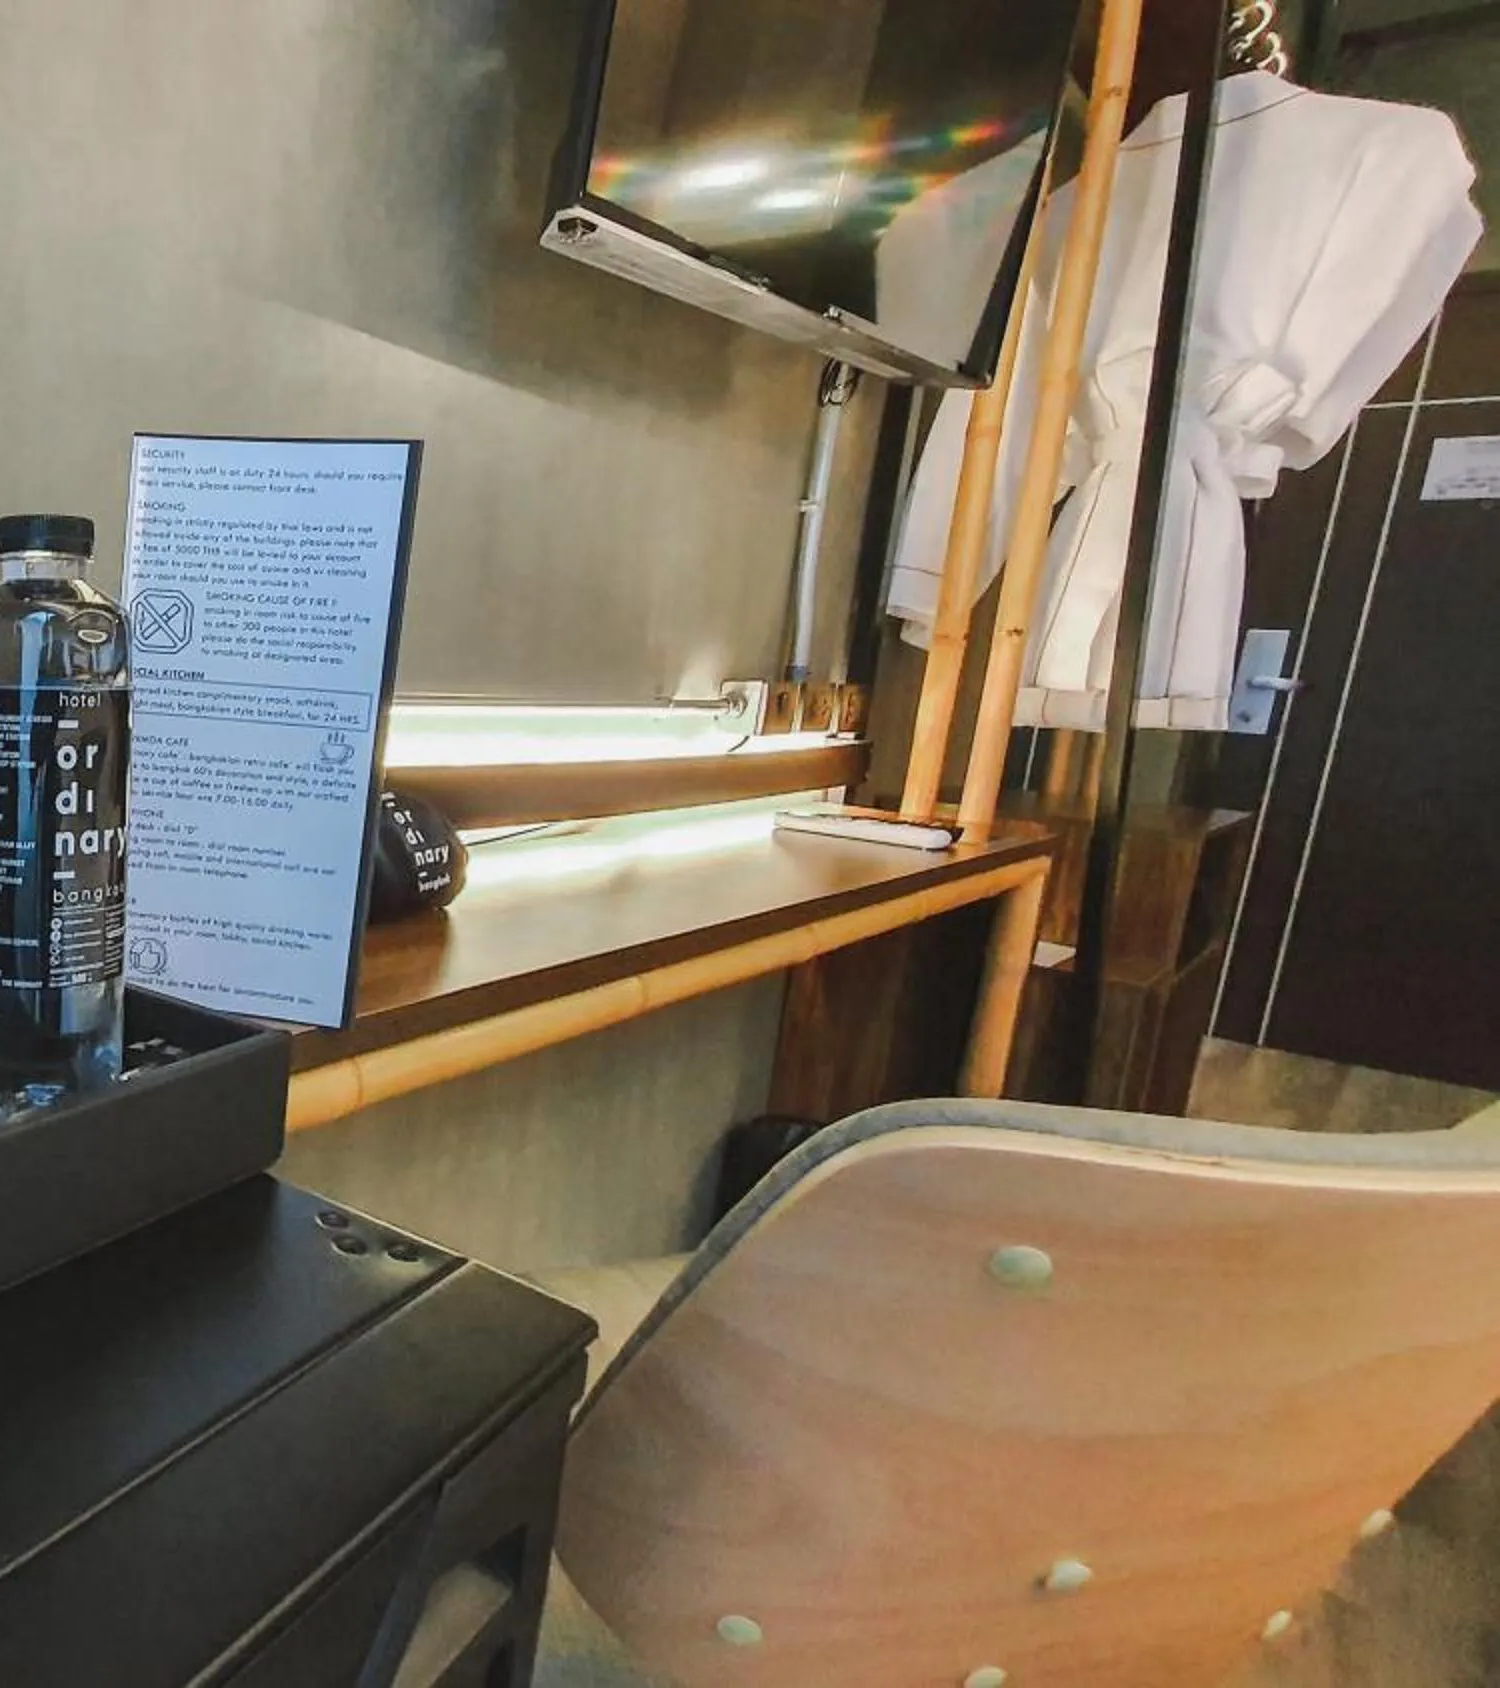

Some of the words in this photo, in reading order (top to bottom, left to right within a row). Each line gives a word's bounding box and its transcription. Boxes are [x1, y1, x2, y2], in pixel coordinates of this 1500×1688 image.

[58, 692, 102, 708] hotel
[56, 744, 100, 771] or
[54, 826, 127, 859] nary
[414, 844, 450, 867] nary
